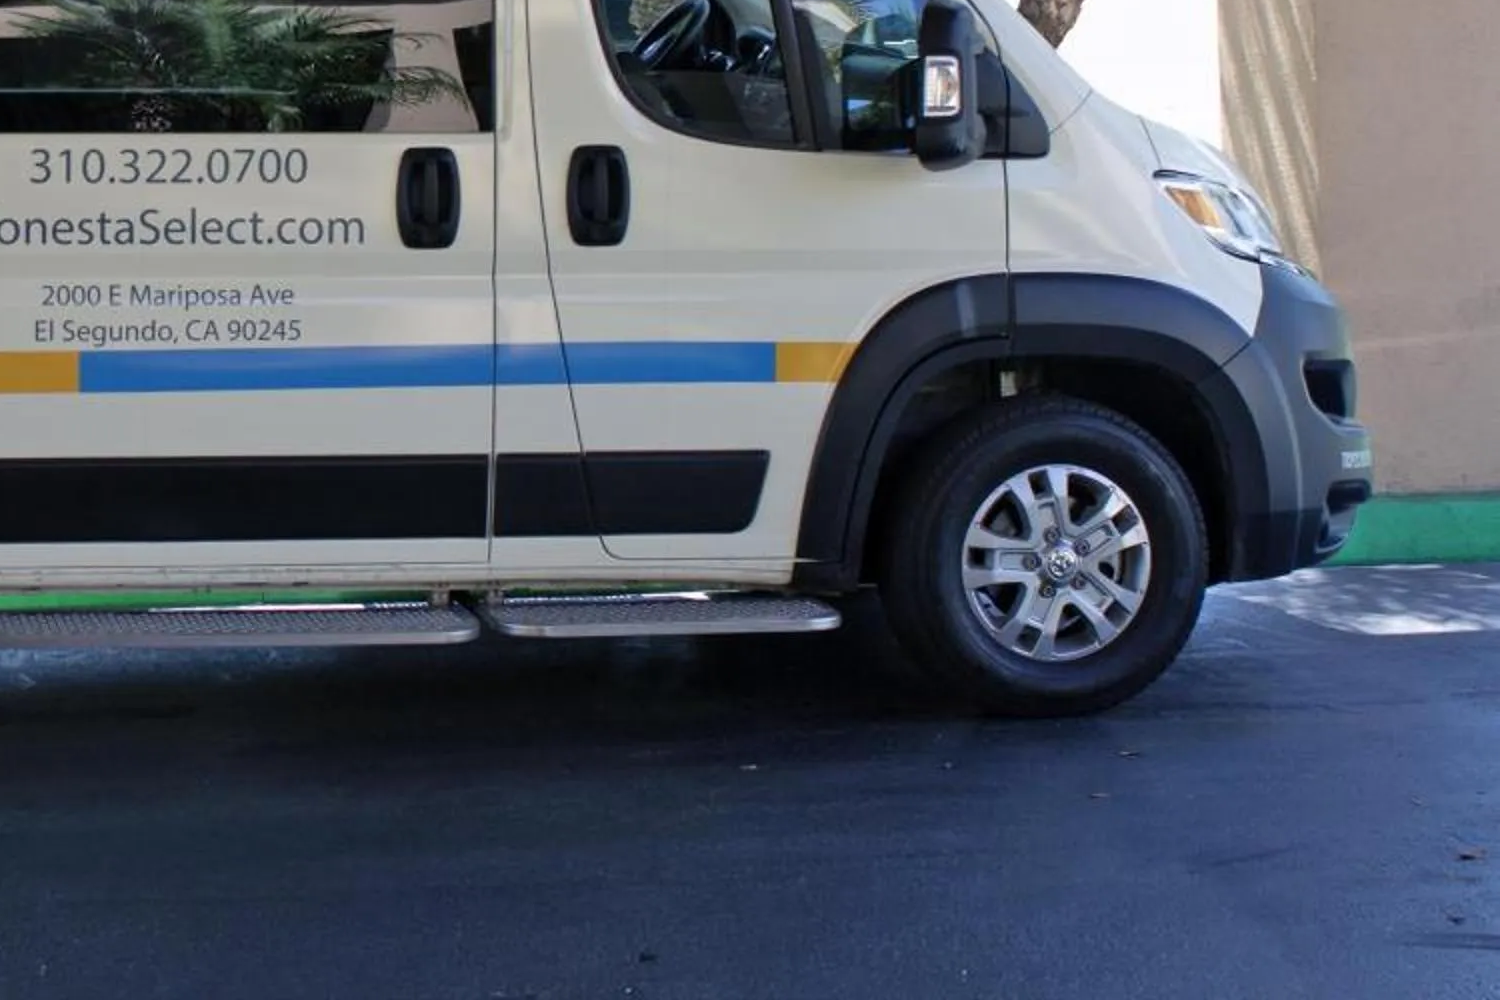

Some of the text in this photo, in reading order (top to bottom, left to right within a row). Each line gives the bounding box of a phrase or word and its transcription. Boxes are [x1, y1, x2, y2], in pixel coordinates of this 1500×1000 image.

[30, 148, 308, 184] 310.322.0700
[42, 283, 295, 311] 2000 E Mariposa Ave
[35, 319, 301, 347] El Segundo, CA 90245
